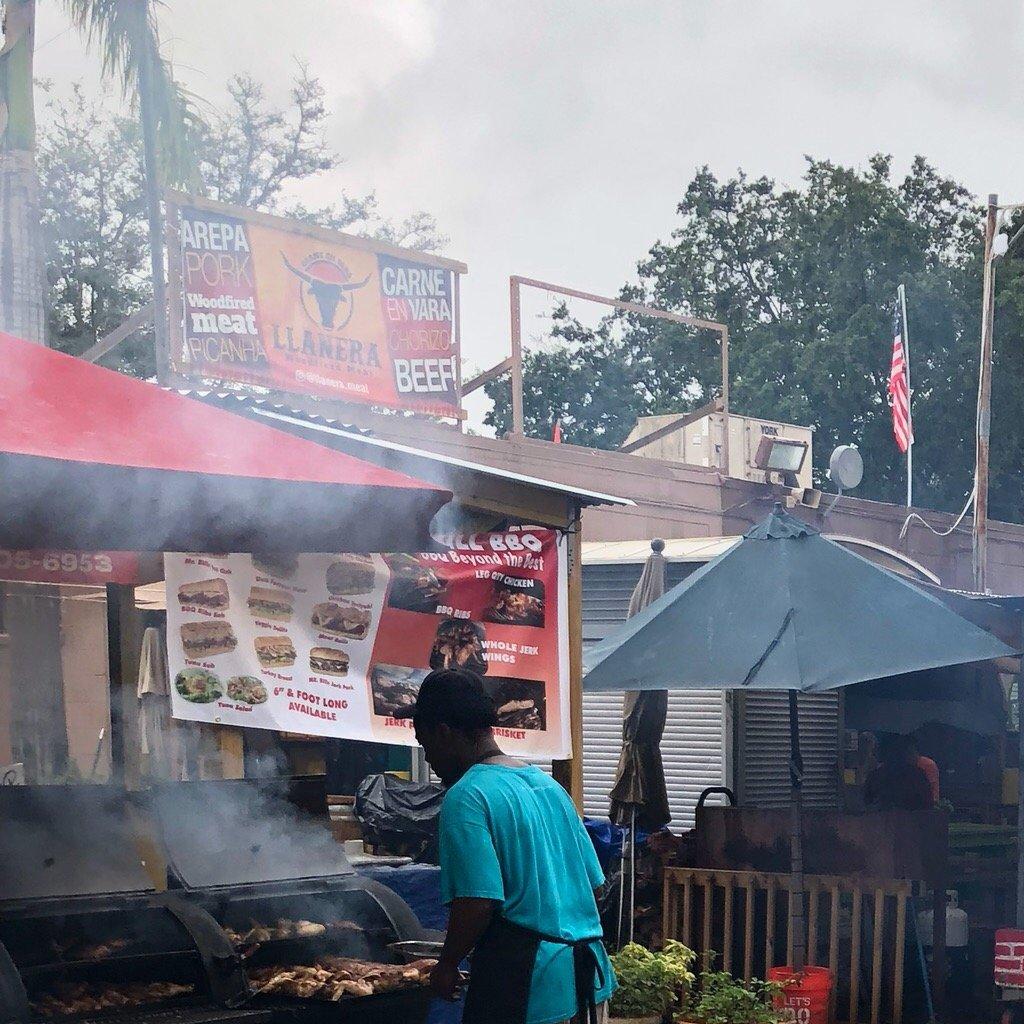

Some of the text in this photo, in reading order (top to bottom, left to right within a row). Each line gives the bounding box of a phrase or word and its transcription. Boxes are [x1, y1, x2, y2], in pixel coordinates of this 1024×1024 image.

[181, 219, 250, 252] AREPA
[185, 252, 252, 288] PORK
[381, 266, 446, 297] CARNE
[386, 298, 452, 322] EN VARA
[191, 311, 258, 335] meat
[188, 337, 268, 362] PICANHA
[272, 323, 382, 369] LLANERA
[388, 328, 450, 351] CHORIZO
[488, 533, 543, 553] BBQ
[448, 550, 503, 567] Beyond
[504, 576, 535, 588] CHICKEN
[435, 605, 452, 616] BBQ
[481, 640, 539, 655] WHOLE JERK
[481, 652, 516, 664] WINGS
[286, 688, 295, 698] &
[296, 690, 321, 706] FOOT
[322, 698, 349, 709] LONG
[288, 702, 337, 721] AVAILABLE
[384, 717, 408, 728] JERK
[784, 997, 811, 1006] LET'S
